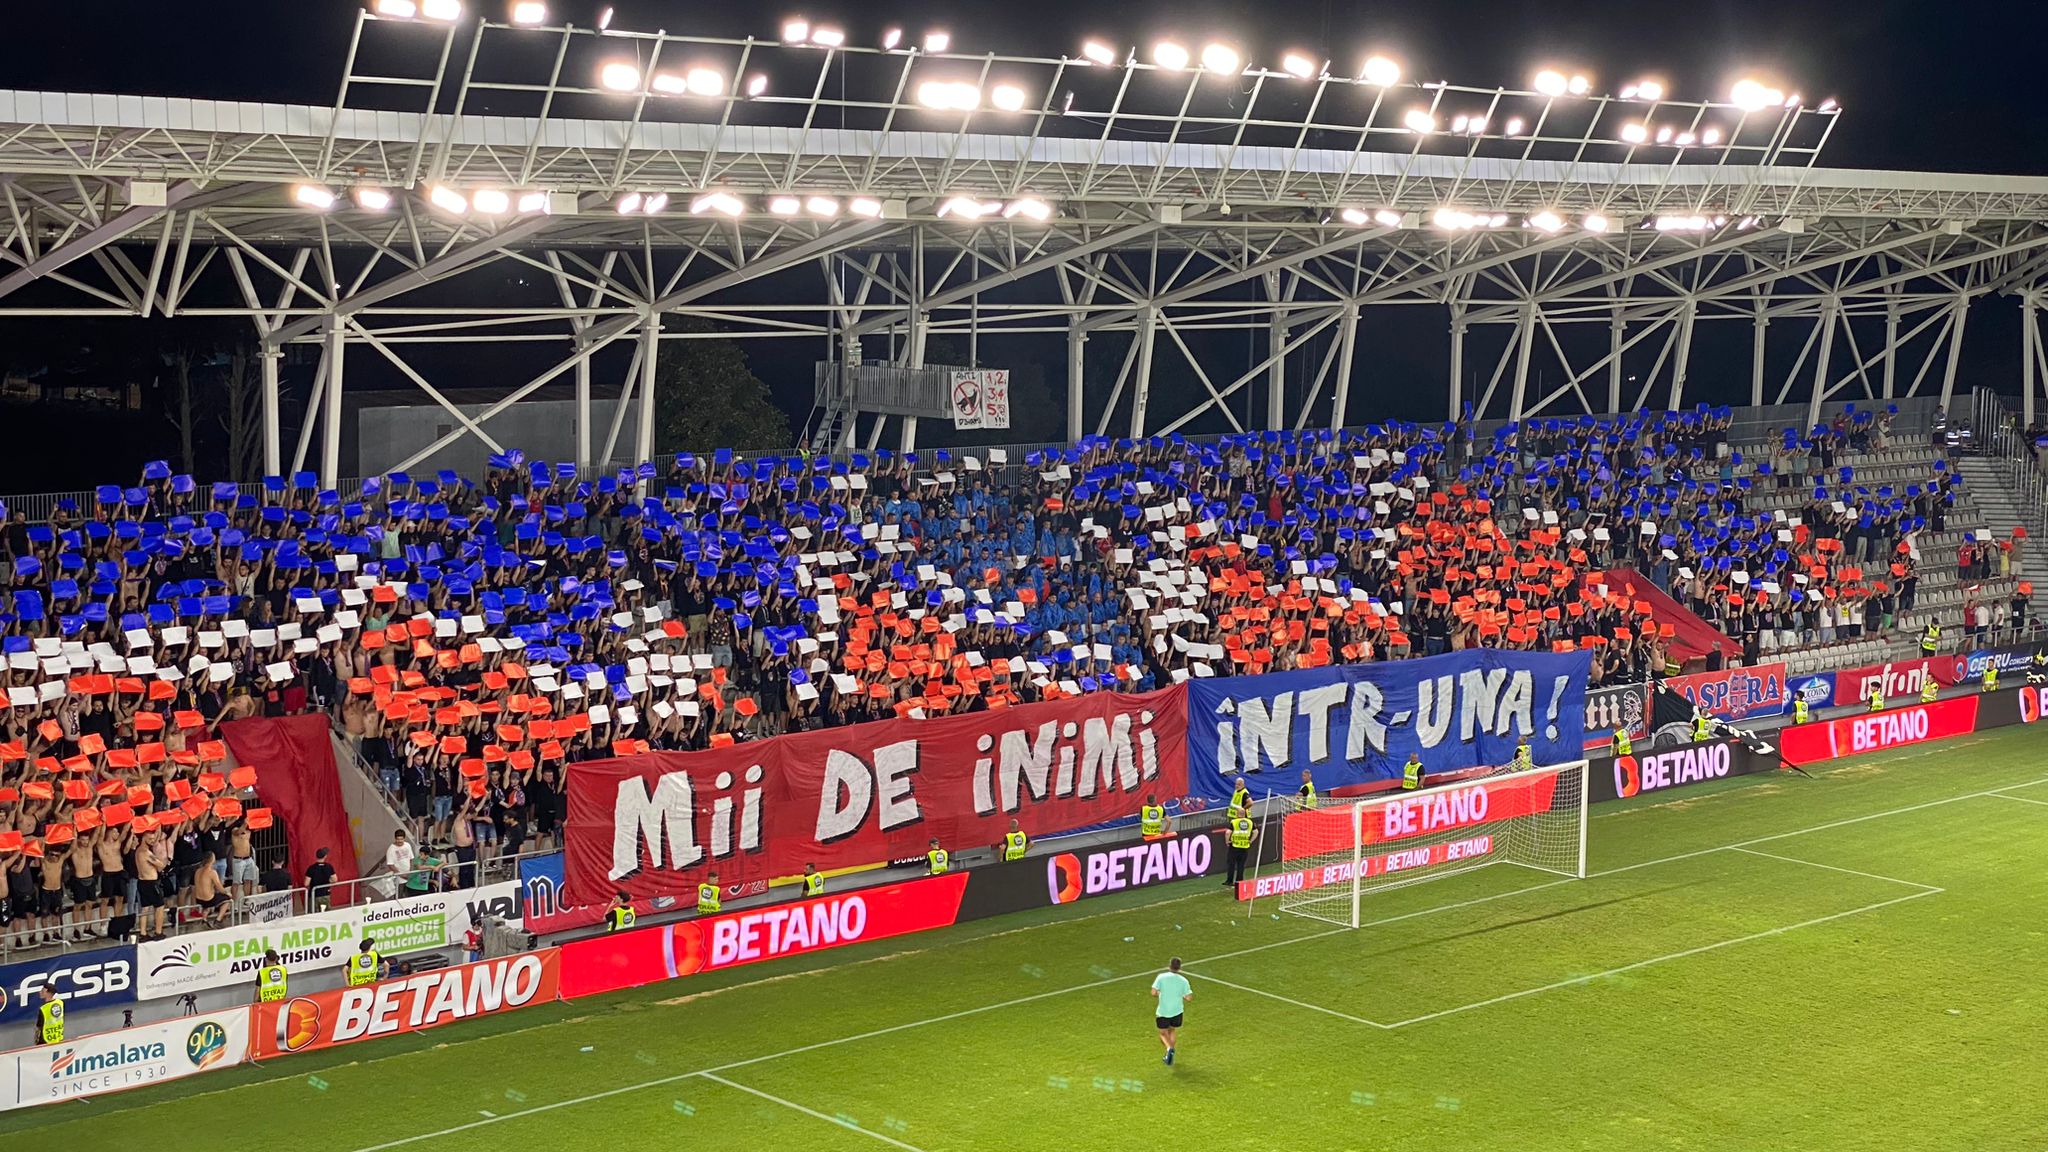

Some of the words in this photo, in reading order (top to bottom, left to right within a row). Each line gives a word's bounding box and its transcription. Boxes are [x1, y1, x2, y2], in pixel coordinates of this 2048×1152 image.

[1853, 708, 1929, 751] BETANO
[1642, 743, 1730, 791] BETANO
[814, 738, 921, 845] DE
[1385, 786, 1488, 837] BETANO
[1086, 834, 1211, 893] BETANO
[1256, 872, 1304, 897] BETANO
[1386, 847, 1429, 872] BETANO
[1447, 836, 1489, 860] BETANO
[363, 901, 445, 923] idealmedia.ro
[712, 897, 867, 966] BETANO
[207, 936, 272, 962] IDEAL
[281, 922, 353, 950] MEDIA
[373, 932, 440, 951] UBLICITARĂ
[13, 960, 130, 1007] FCSB
[332, 954, 543, 1042] BETANO
[50, 1042, 165, 1079] Himalaya
[52, 1076, 110, 1097] SINCE
[124, 1066, 167, 1083] 1930
